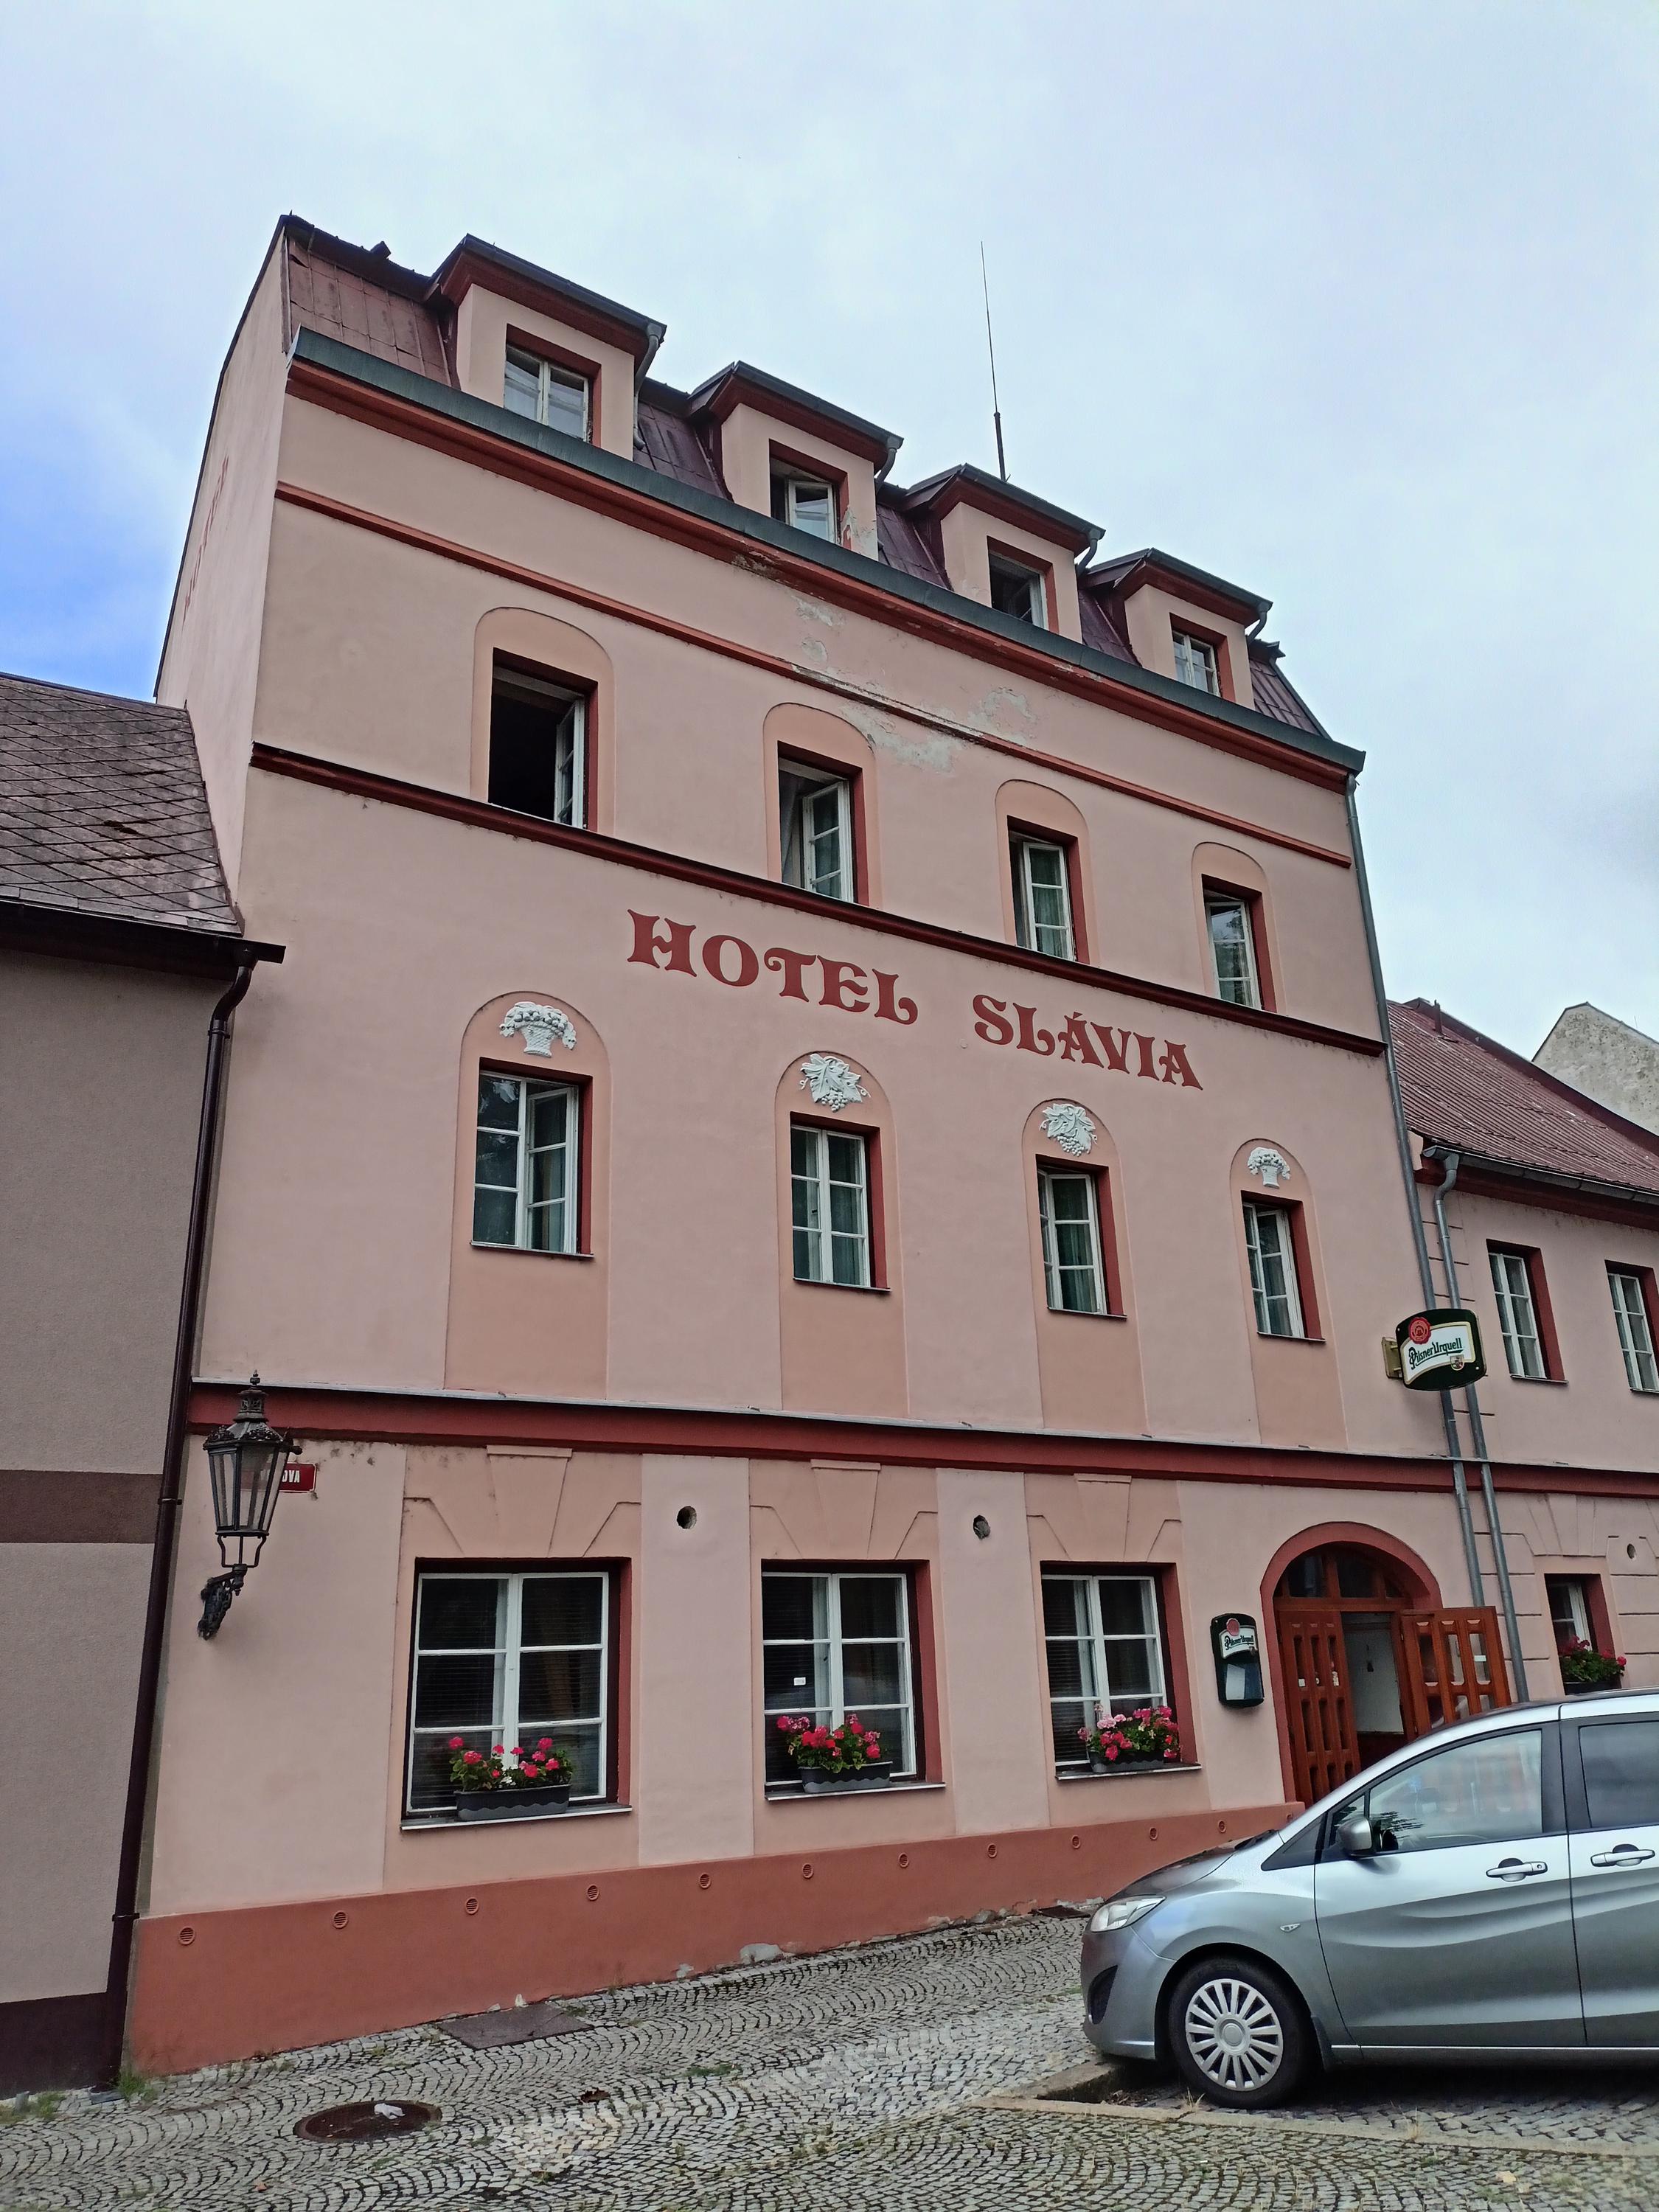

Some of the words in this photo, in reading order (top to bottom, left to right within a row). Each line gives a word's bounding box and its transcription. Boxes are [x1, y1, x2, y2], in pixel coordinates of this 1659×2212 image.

[627, 909, 919, 1026] HOTEL
[973, 994, 1203, 1091] SLÁVIA
[1408, 1346, 1433, 1370] Pilsner
[1432, 1338, 1463, 1355] Urquell
